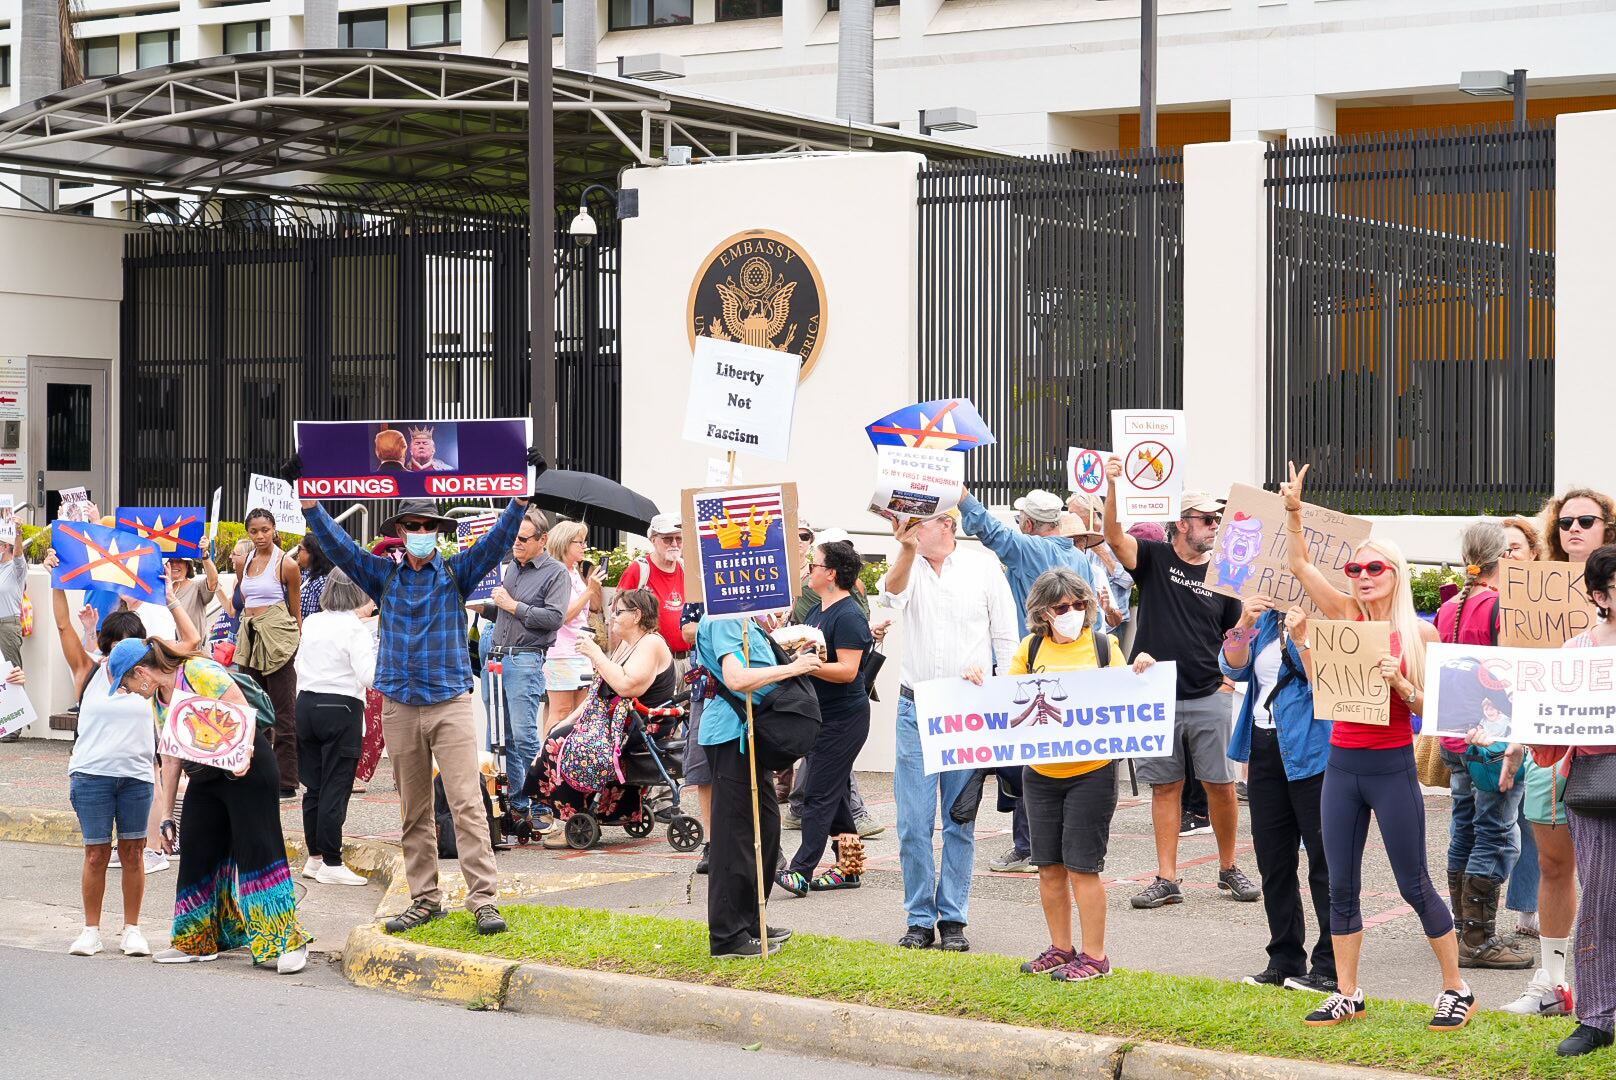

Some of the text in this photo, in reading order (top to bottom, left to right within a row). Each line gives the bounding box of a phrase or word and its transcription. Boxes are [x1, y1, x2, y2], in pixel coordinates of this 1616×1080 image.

[720, 240, 796, 268] EMBASSY
[799, 314, 819, 359] ERICA
[715, 362, 764, 387] Liberty
[728, 393, 752, 410] Not
[706, 424, 759, 445] Fascism
[1146, 421, 1169, 431] Kings
[888, 451, 952, 462] PEACEFUL
[892, 458, 950, 472] PROTEST
[302, 480, 333, 495] NO
[334, 478, 394, 494] KINGS
[432, 476, 523, 492] NO REYES
[1269, 522, 1352, 570] HTRED
[715, 554, 775, 569] REJECTING
[714, 566, 780, 586] KINGS
[1507, 566, 1588, 604] FUCK
[721, 583, 776, 596] SINCE 1776
[1500, 607, 1589, 643] TRUMP
[1316, 625, 1360, 654] NO
[928, 702, 1166, 736] KNOW JUSTICE
[1335, 704, 1388, 722] SINCE 1776
[1538, 703, 1616, 718] is Trump
[1534, 722, 1615, 735] Tradema
[212, 744, 245, 767] KINGS
[941, 734, 1166, 766] KNOW DEMOCRACY
